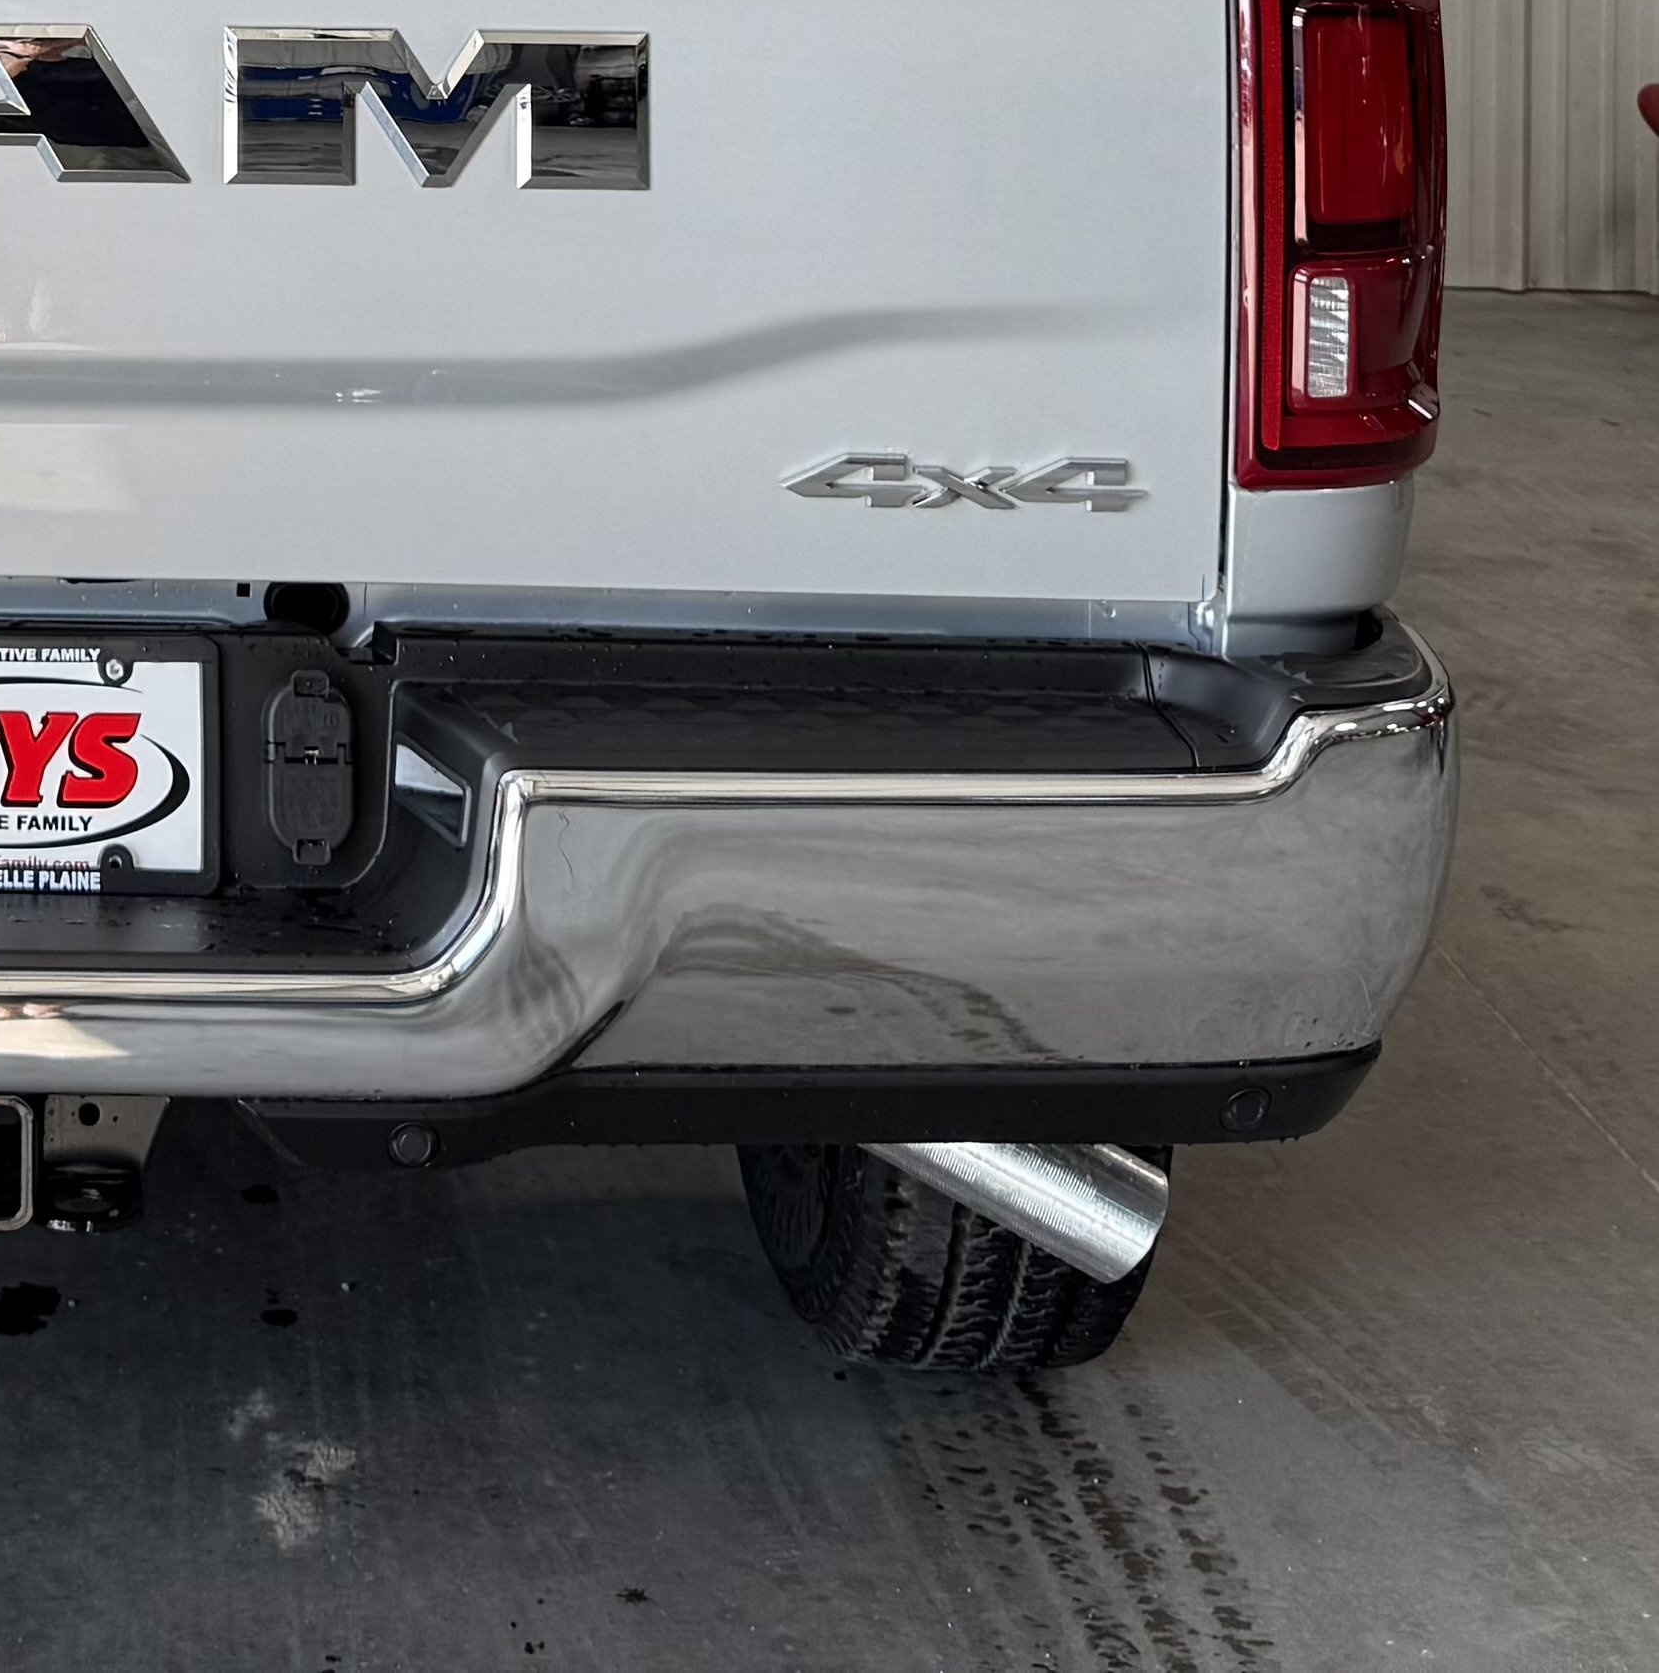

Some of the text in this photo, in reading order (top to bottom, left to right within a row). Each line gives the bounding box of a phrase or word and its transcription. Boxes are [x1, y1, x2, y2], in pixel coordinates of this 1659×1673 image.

[41, 647, 101, 663] FAMILY
[16, 814, 93, 833] FAMILY
[38, 870, 101, 891] PLAINE
